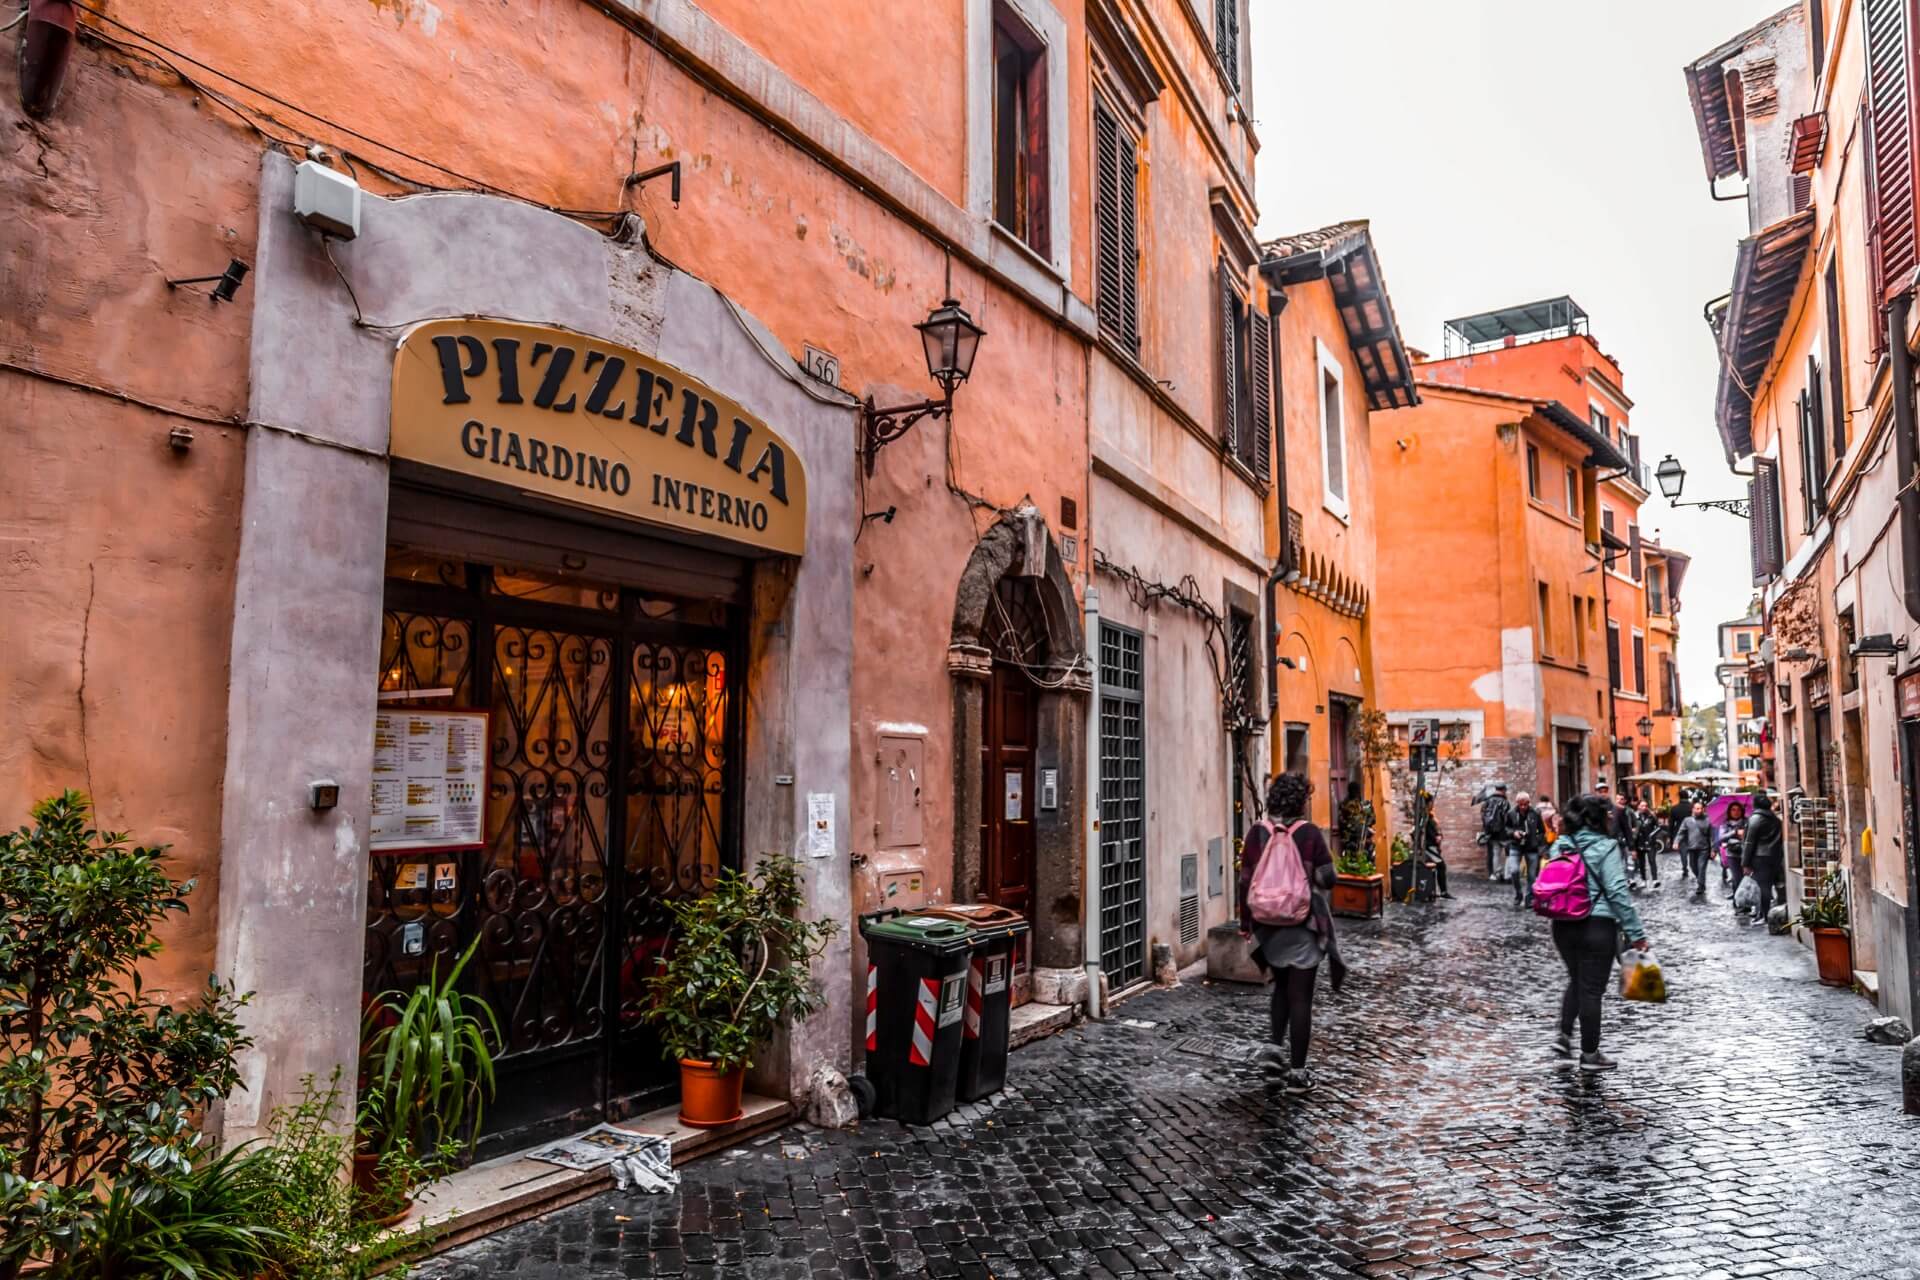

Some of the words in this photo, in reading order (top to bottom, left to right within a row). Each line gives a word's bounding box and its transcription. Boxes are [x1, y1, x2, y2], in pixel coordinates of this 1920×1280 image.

[807, 351, 836, 384] 156
[431, 335, 789, 506] PIZZERIA
[461, 420, 631, 496] GIARDINO
[651, 474, 768, 532] INTERNO
[1061, 537, 1076, 558] 157
